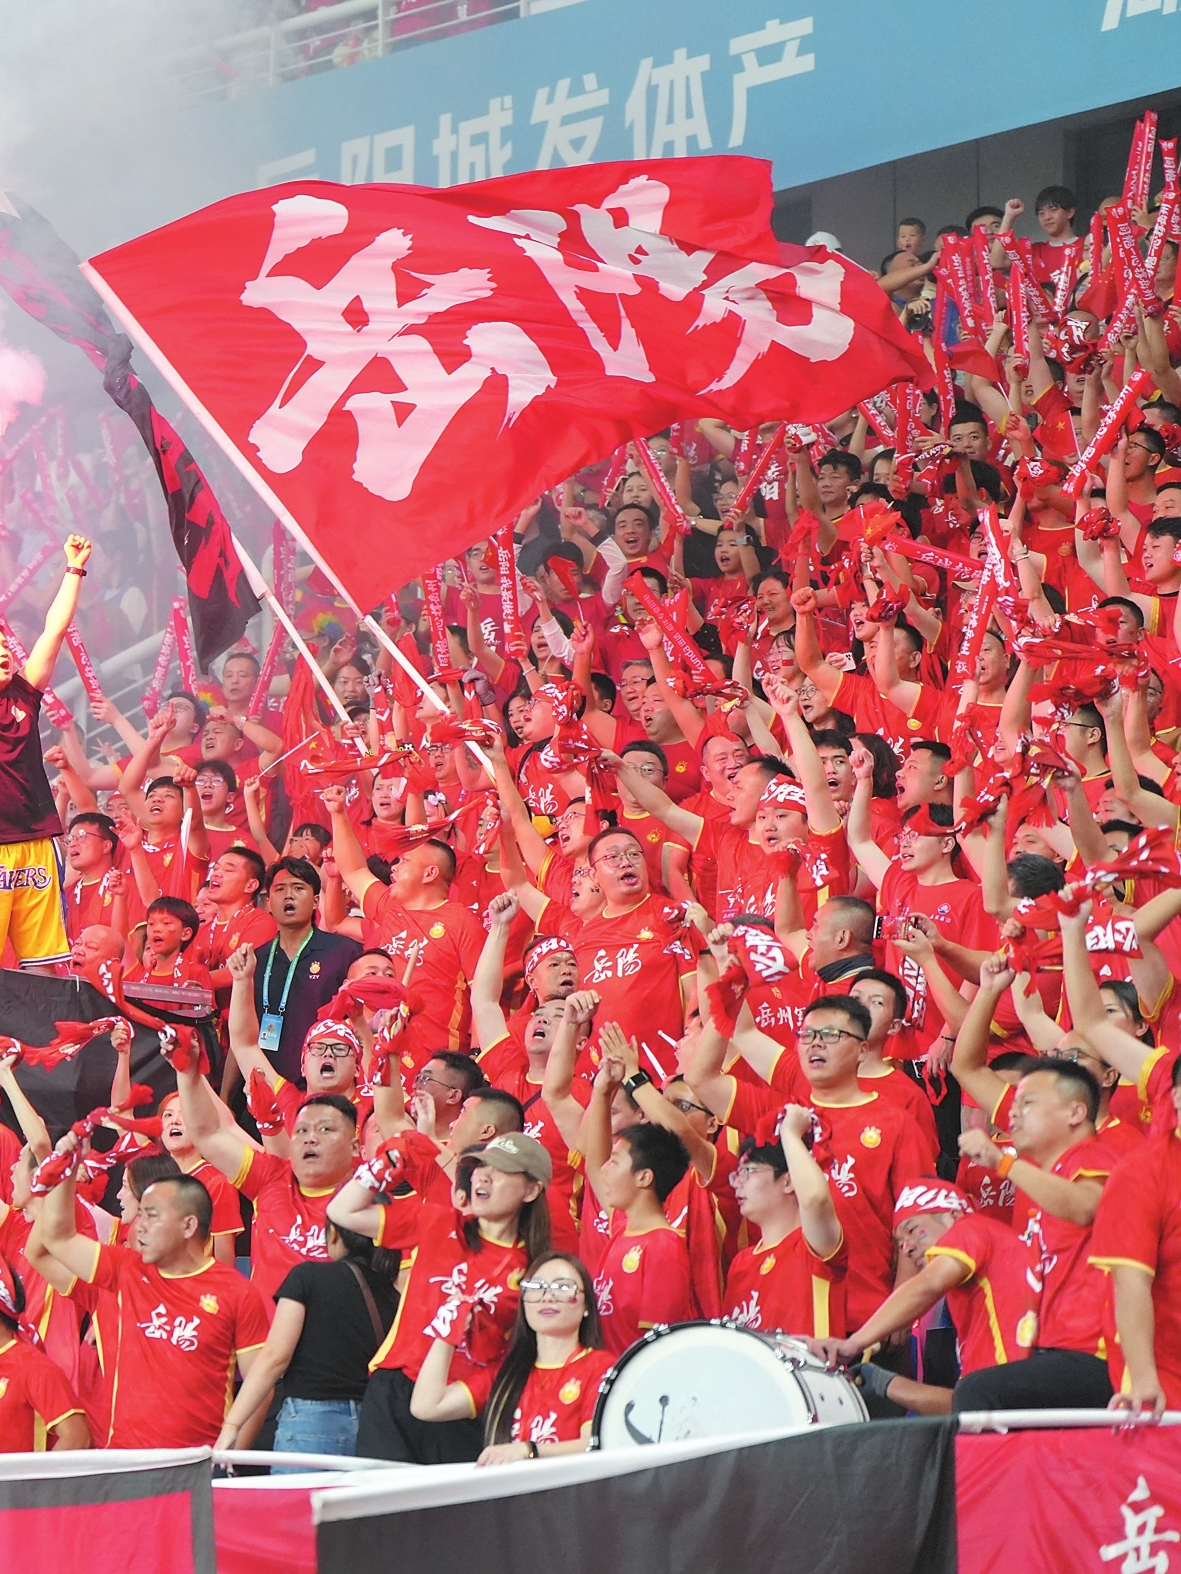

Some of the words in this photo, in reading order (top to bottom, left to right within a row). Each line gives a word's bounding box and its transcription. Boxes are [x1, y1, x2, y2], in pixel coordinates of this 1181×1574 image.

[256, 16, 816, 188] 阳城发体产
[497, 546, 512, 574] 岳阳
[680, 643, 706, 673] xunda
[583, 943, 642, 984] 岳陽
[137, 1304, 201, 1352] 岳陽
